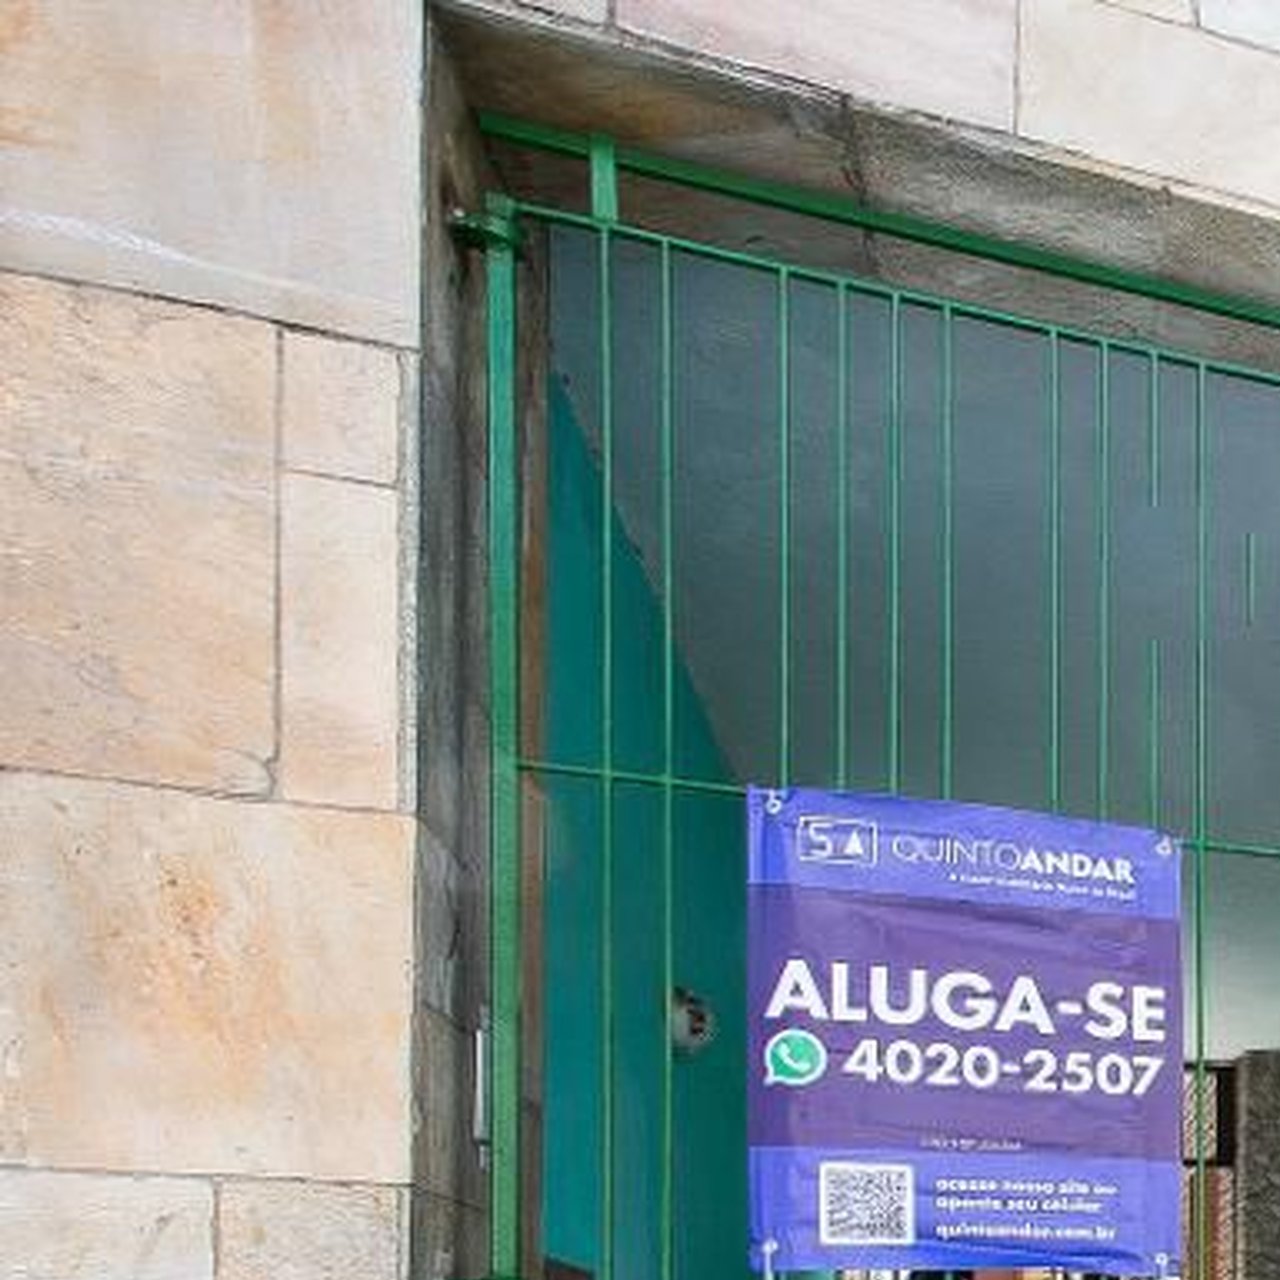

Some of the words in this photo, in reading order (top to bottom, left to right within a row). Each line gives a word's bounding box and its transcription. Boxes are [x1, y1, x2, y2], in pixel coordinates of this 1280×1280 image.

[892, 834, 1135, 884] QUINTOANDAR
[764, 958, 1167, 1043] ALUGA-SE
[842, 1038, 1166, 1098] 4020-2507
